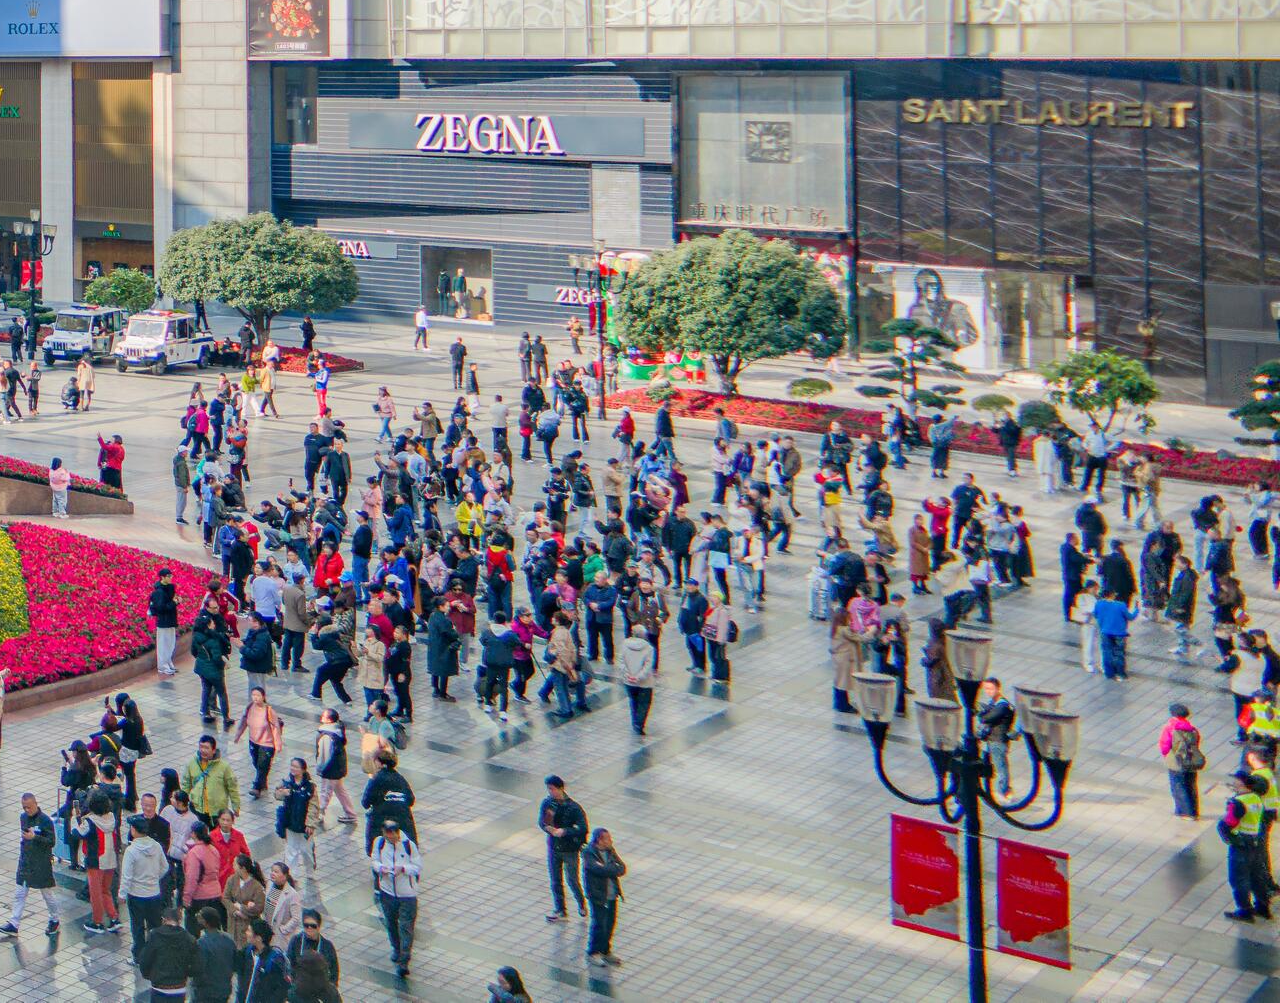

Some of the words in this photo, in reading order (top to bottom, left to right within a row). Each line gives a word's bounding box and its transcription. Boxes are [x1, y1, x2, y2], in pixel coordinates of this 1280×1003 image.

[8, 22, 59, 35] ROLEX
[902, 98, 1008, 125] SAINT
[1015, 100, 1194, 129] LAURENT
[415, 112, 564, 155] ZEGNA
[690, 202, 828, 227] 重庆时代广场
